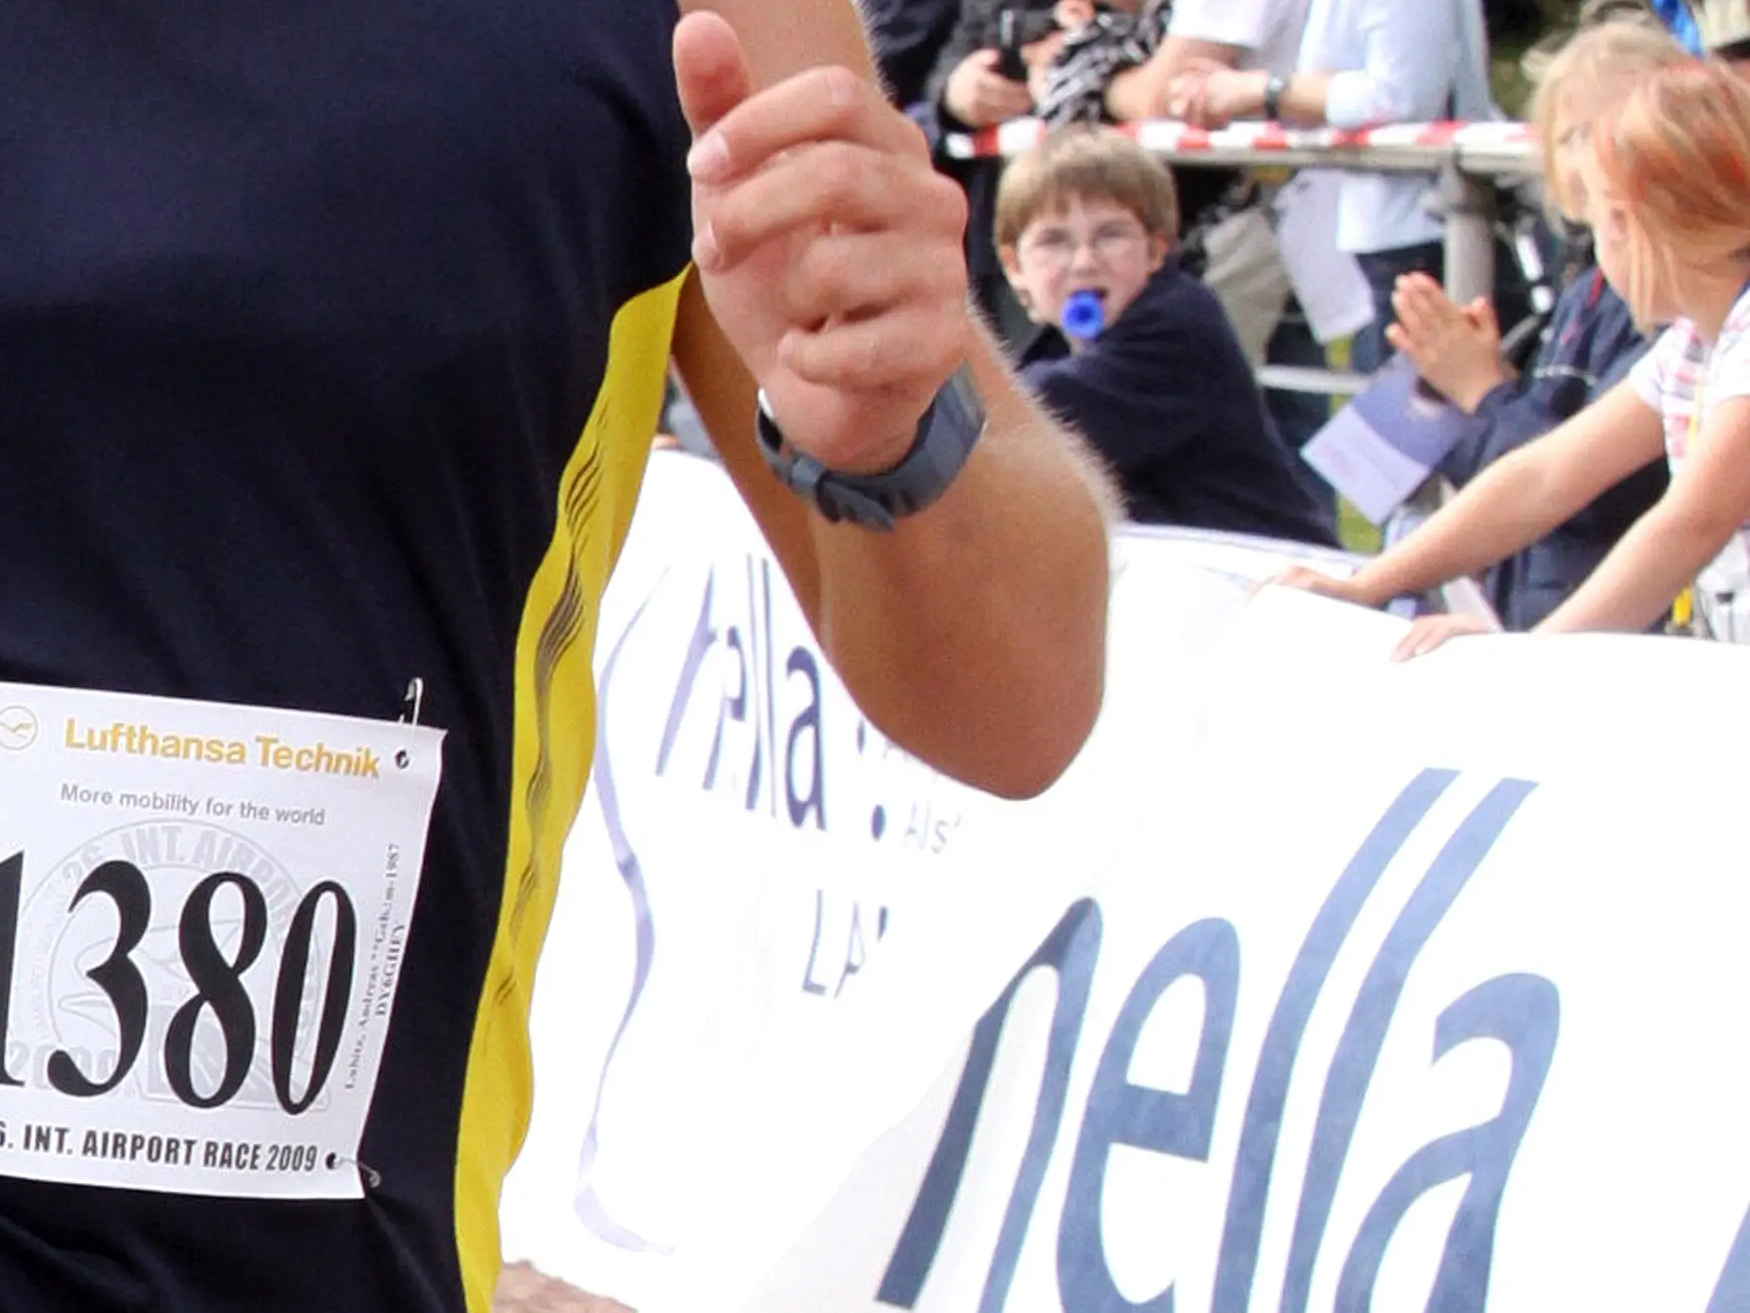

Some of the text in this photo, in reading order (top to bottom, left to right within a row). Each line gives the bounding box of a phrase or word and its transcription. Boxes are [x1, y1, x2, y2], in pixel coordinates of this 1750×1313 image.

[64, 717, 381, 779] Lufthansa Technik
[61, 782, 326, 827] More mobility for the world
[874, 766, 1563, 1313] nella
[23, 1124, 74, 1156] INT.
[81, 1128, 197, 1167] AIRPORT
[202, 1141, 261, 1172] RACE
[264, 1143, 319, 1174] 2009
